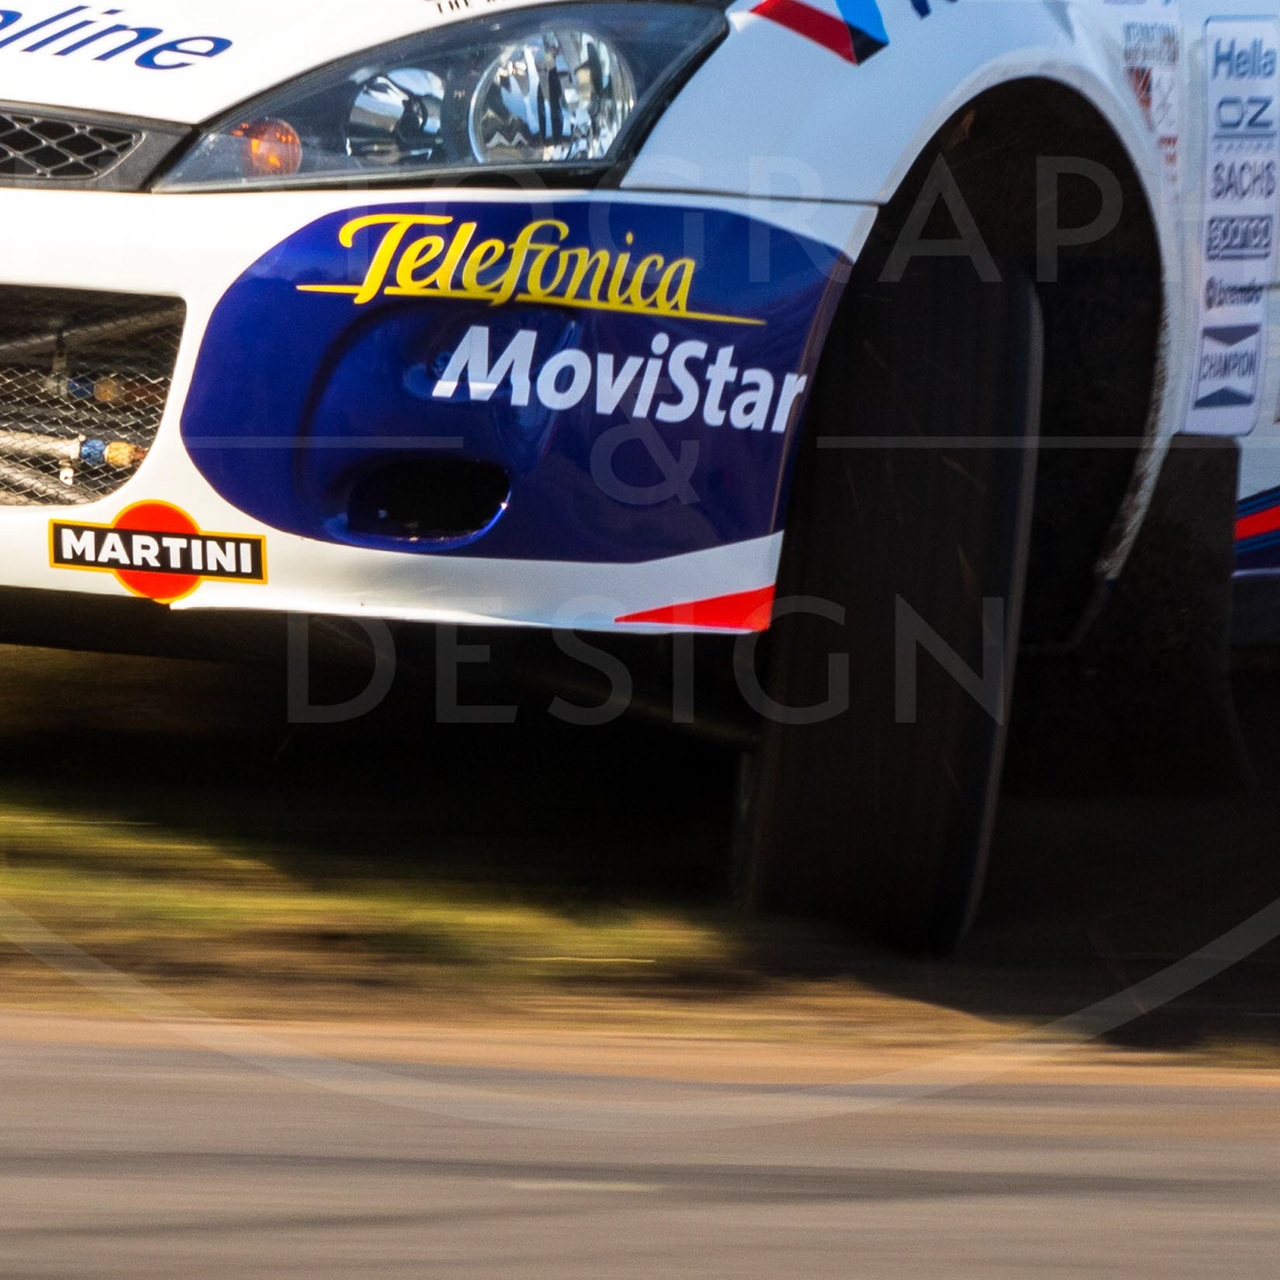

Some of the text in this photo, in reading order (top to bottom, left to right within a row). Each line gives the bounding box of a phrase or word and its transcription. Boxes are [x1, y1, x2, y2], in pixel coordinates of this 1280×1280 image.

[1211, 37, 1277, 81] Hella
[1211, 160, 1276, 200] SACHS
[431, 325, 806, 433] MoviStar
[1201, 349, 1257, 380] CHAMPION
[61, 527, 254, 574] MARTINI
